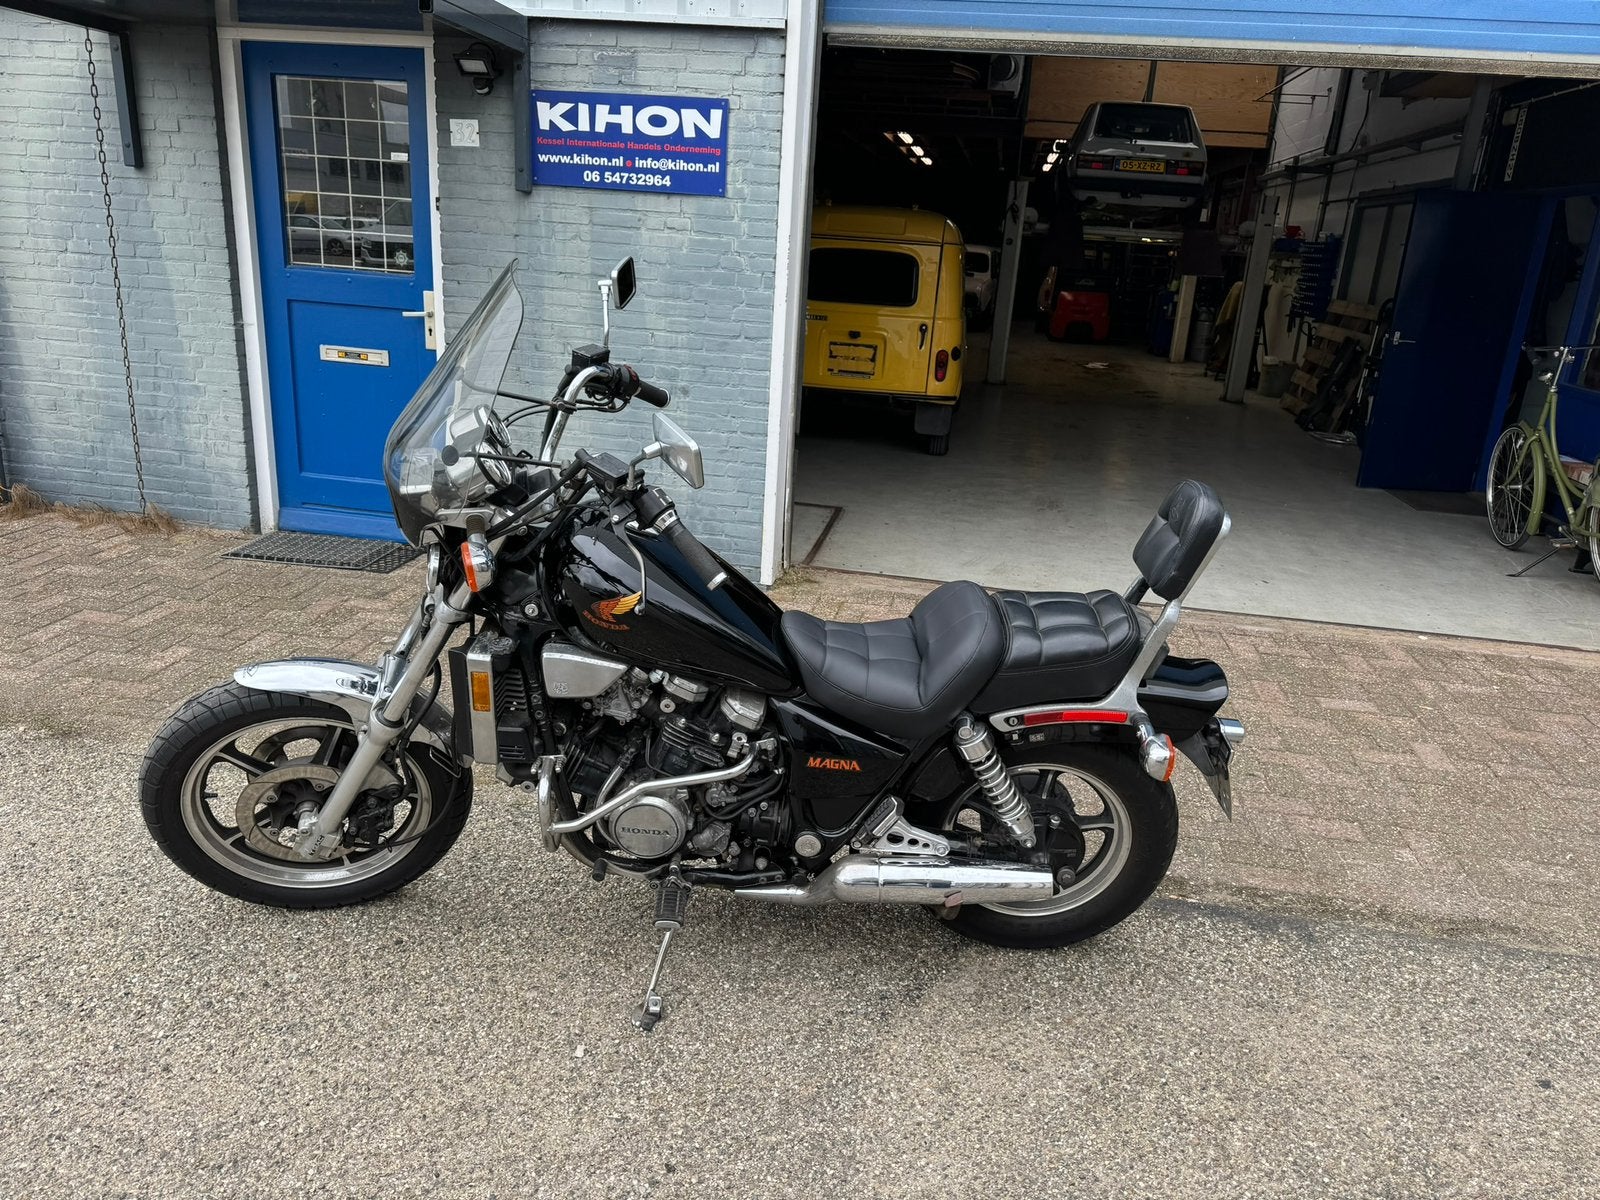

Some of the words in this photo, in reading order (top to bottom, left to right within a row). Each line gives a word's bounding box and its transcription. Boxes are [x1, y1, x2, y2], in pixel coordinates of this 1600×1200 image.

[536, 101, 723, 139] KIHON
[455, 122, 475, 143] 32
[537, 136, 565, 146] Kessel
[566, 138, 625, 149] Internationale
[627, 142, 662, 151] Handels
[664, 143, 721, 156] Onderneming
[538, 153, 624, 167] www.kihon.nl
[635, 157, 720, 173] info@kihon.nl
[583, 170, 600, 182] 06
[604, 171, 671, 187] 54732964
[807, 756, 861, 772] MAGNA
[621, 826, 671, 836] HONDA
